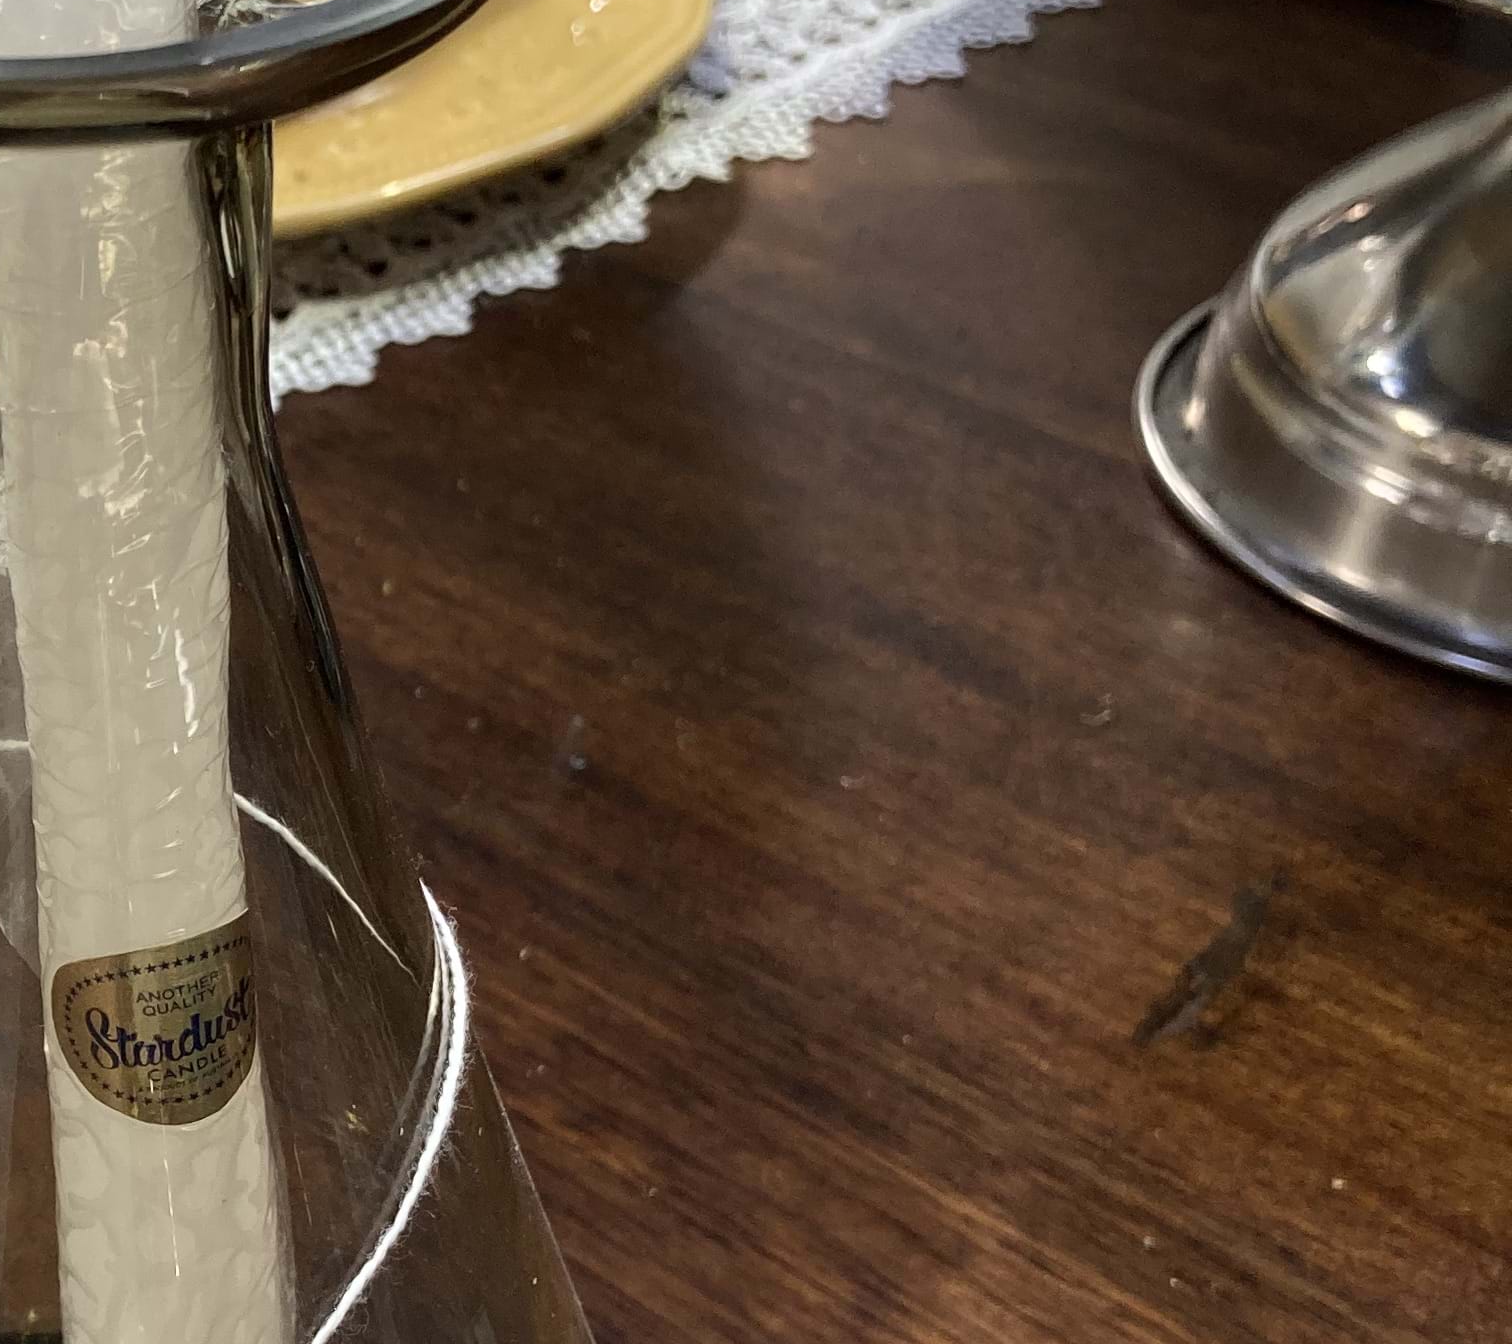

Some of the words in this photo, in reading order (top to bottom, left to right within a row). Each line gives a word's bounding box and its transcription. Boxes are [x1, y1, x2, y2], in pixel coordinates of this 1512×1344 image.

[136, 971, 219, 1003] ANOTHER
[142, 984, 216, 1016] QUALITY
[85, 976, 250, 1069] Stardust
[148, 1043, 226, 1081] CANDLE
